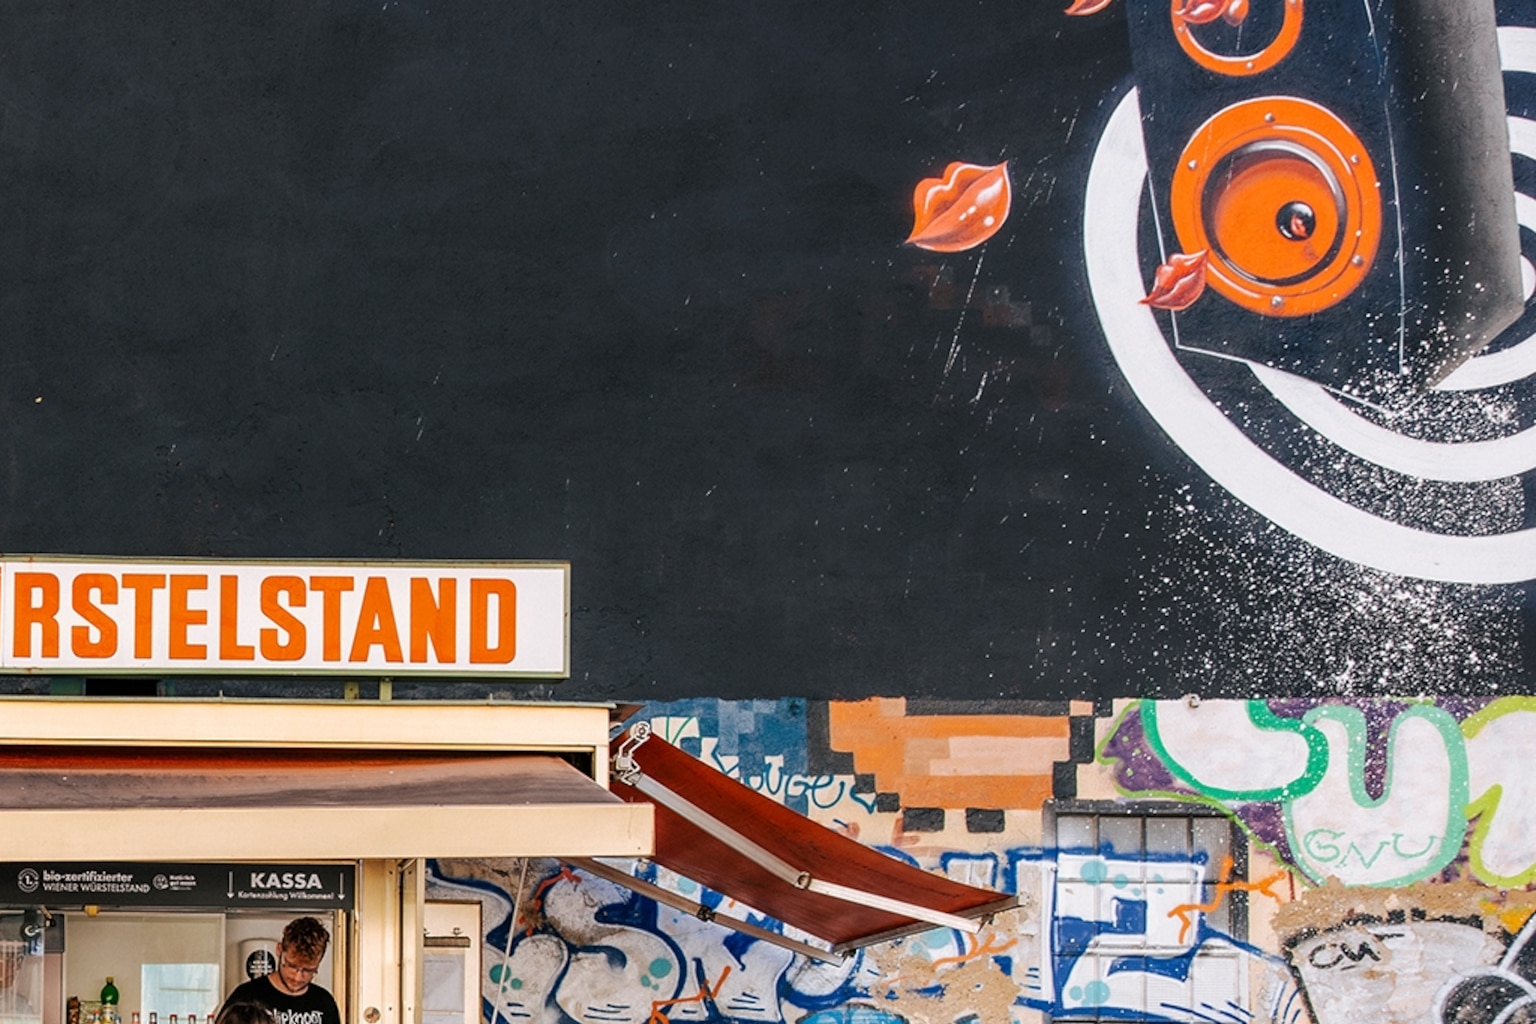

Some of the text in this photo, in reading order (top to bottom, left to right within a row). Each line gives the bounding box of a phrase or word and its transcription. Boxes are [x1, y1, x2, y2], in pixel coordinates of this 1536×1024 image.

[43, 870, 133, 882] bio-zertifizierter
[250, 872, 323, 889] KASSA
[43, 881, 151, 894] WIENER WÜRSTELSTAND
